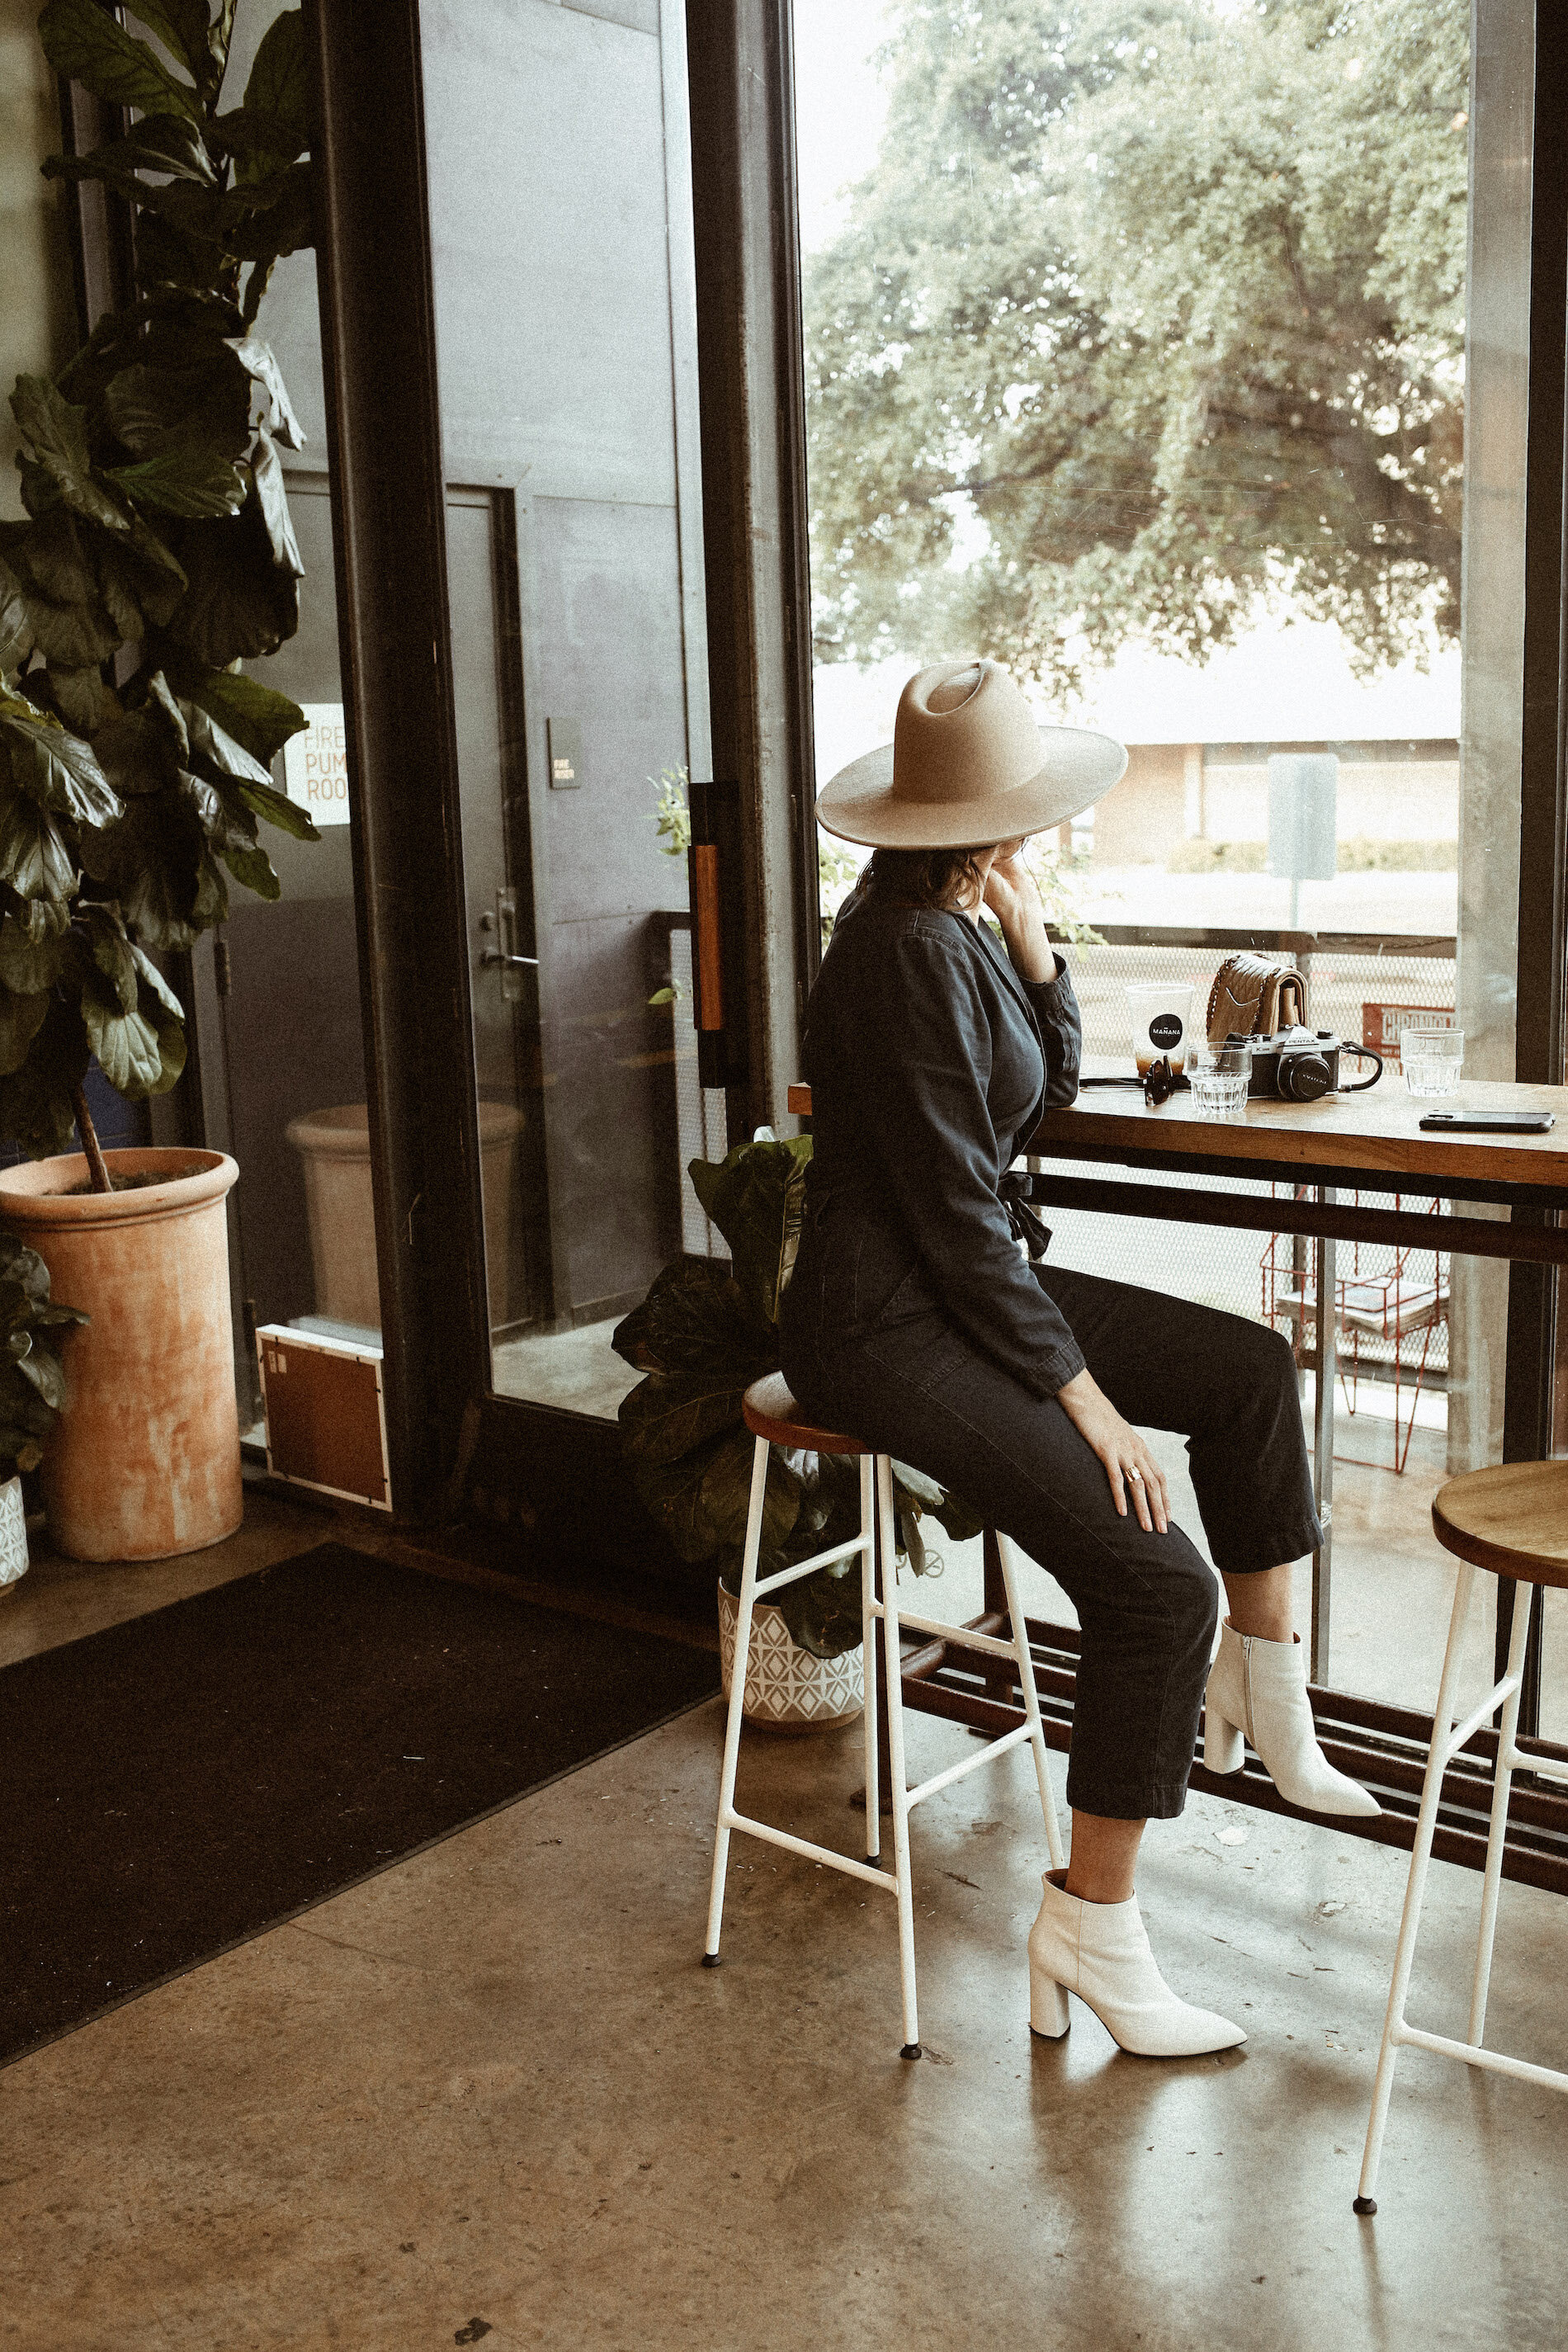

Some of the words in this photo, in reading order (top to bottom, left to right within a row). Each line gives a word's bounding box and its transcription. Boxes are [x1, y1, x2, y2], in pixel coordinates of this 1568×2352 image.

[305, 726, 345, 749] FIRE
[305, 753, 347, 774] PUM
[307, 778, 347, 800] ROO
[1152, 1027, 1180, 1035] MAÑANA
